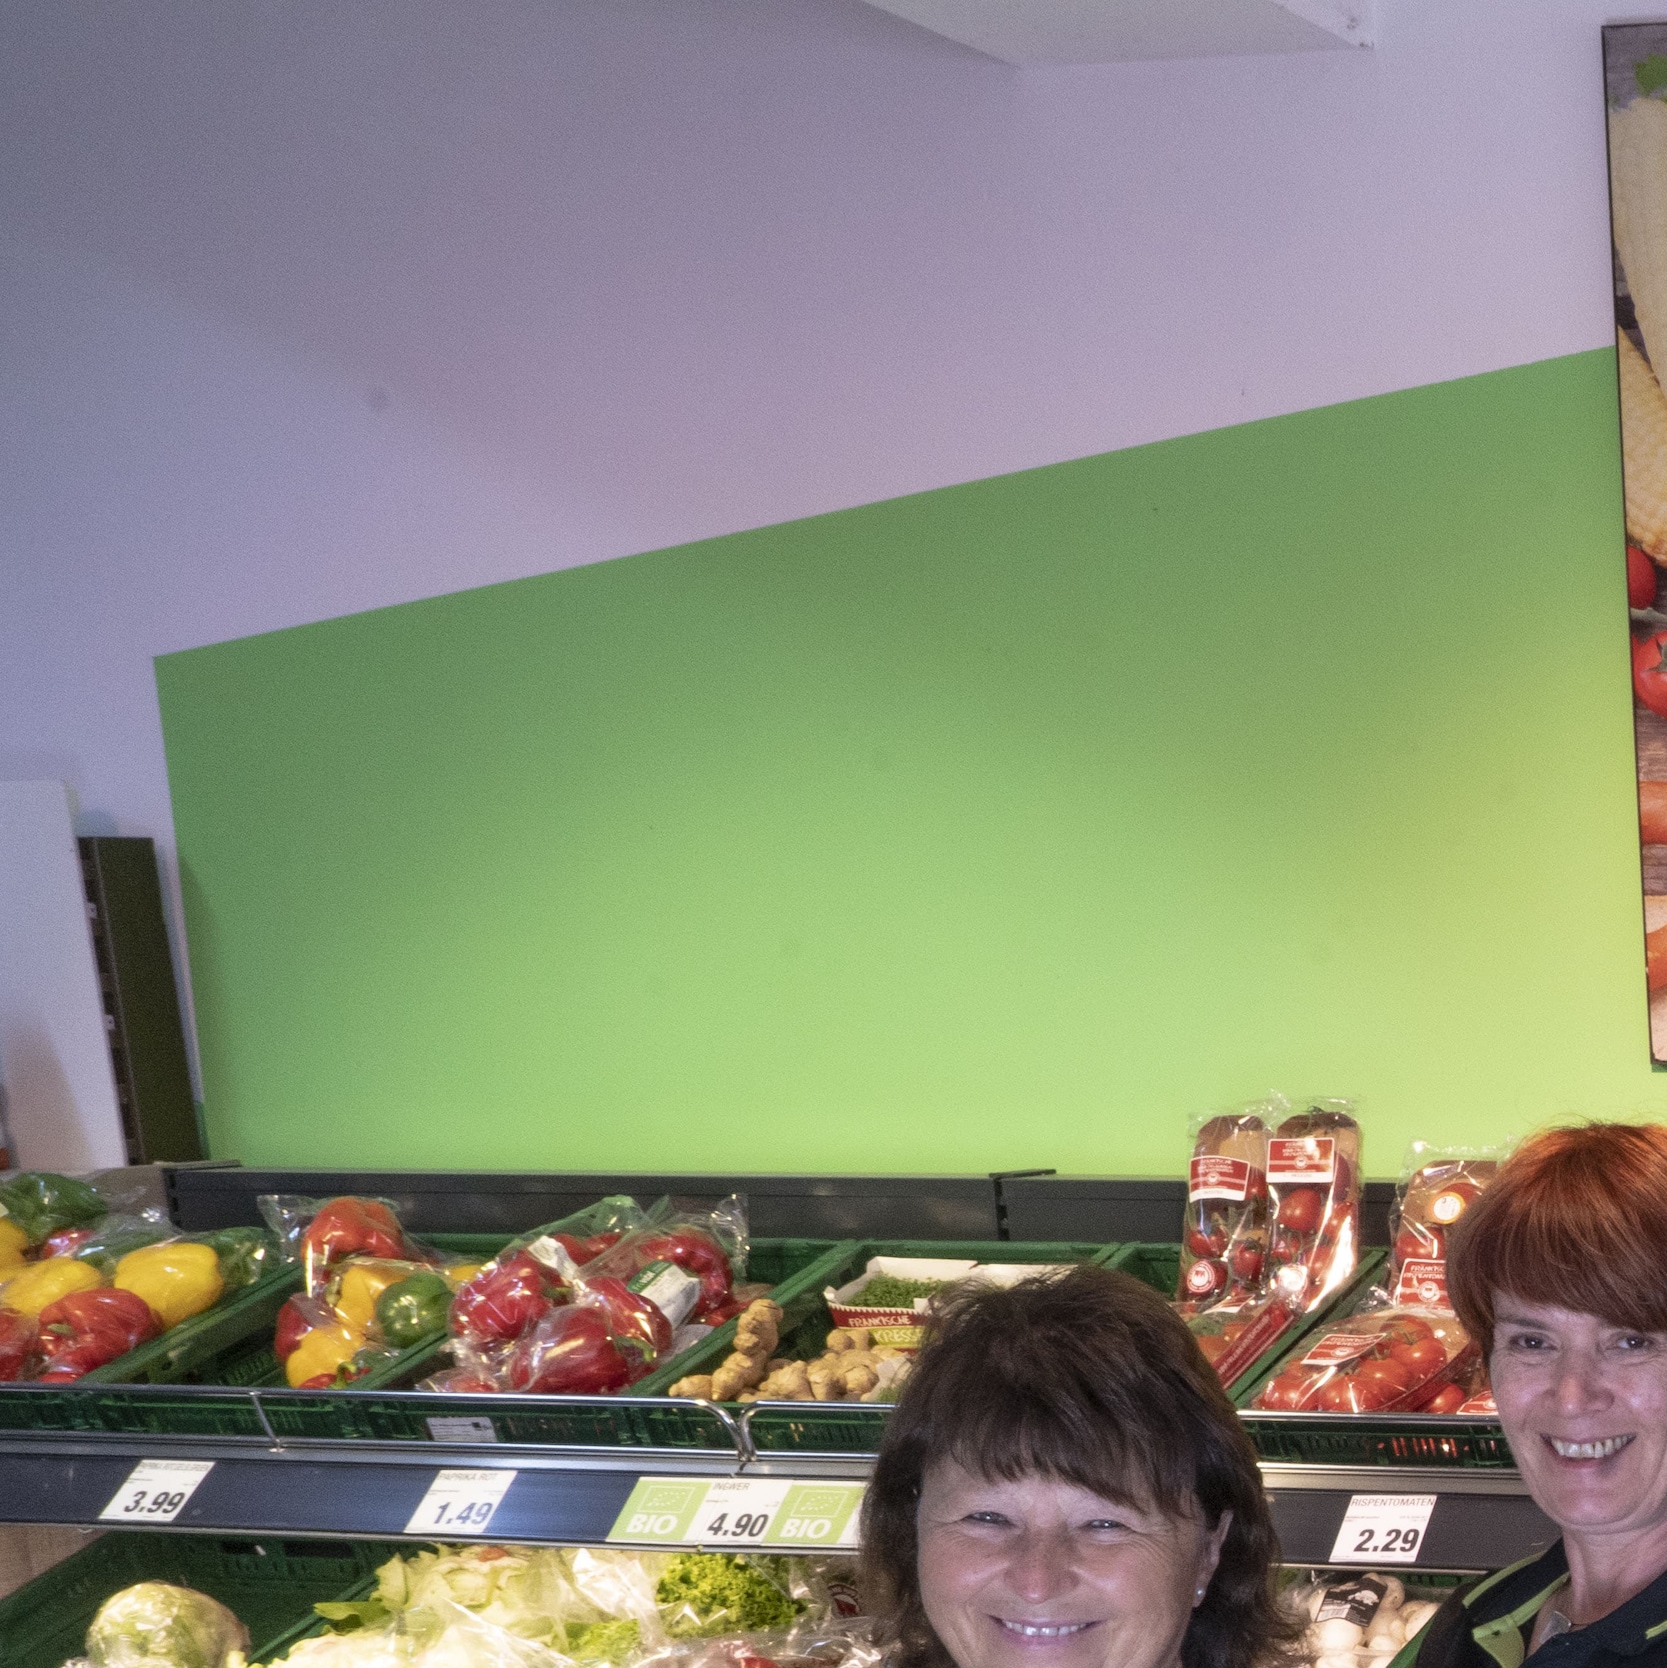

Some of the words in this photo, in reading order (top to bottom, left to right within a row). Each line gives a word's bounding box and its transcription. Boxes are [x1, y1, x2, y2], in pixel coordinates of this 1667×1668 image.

[124, 1490, 186, 1513] 3.99
[434, 1501, 494, 1525] 1.49
[1350, 1498, 1435, 1506] RISPENTOMATEN
[625, 1514, 678, 1535] BIO
[706, 1513, 769, 1537] 4.90
[779, 1518, 832, 1540] BIO
[1353, 1528, 1420, 1552] 2.29
